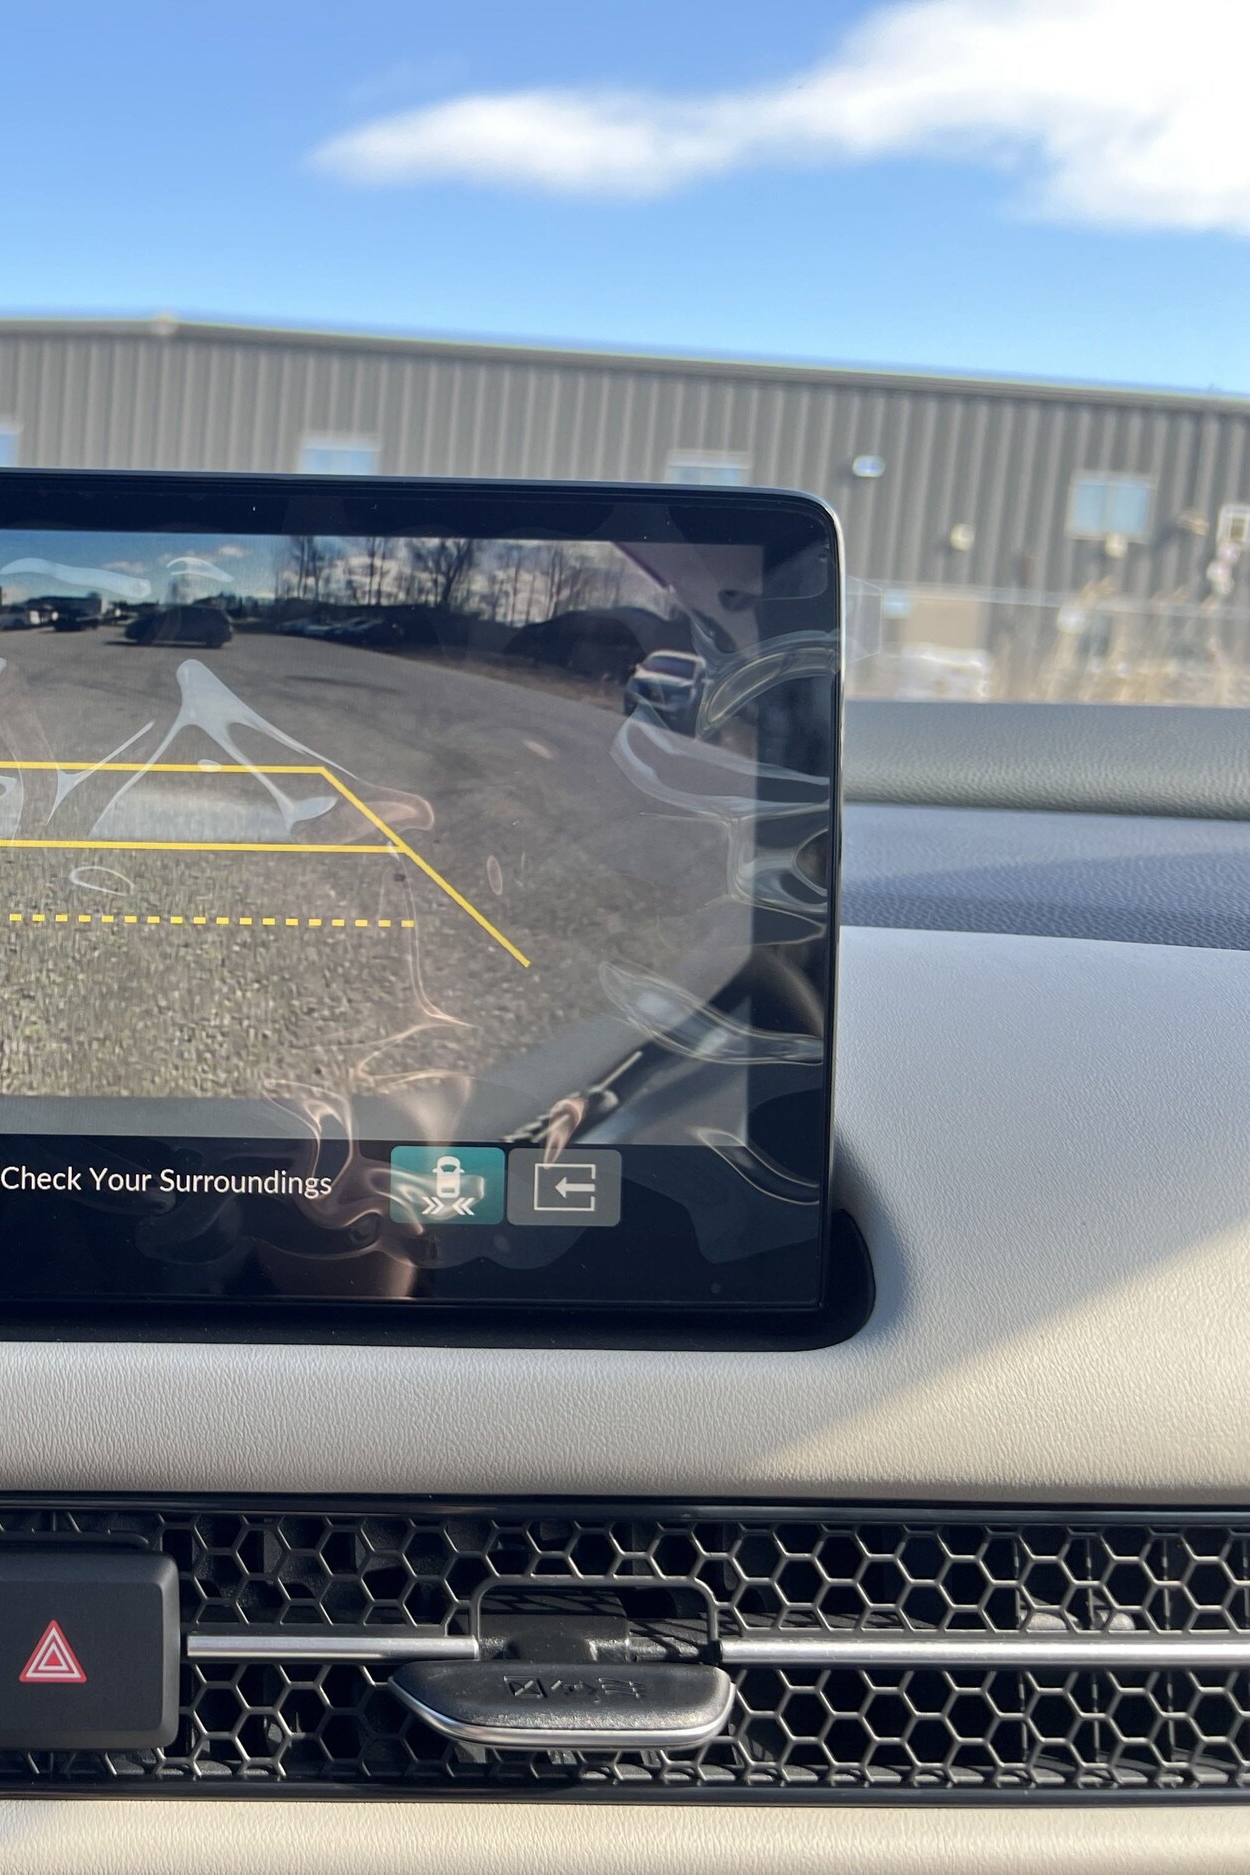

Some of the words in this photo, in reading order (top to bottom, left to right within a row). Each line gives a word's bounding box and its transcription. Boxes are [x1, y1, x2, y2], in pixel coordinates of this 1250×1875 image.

[1, 1166, 82, 1191] Check
[89, 1167, 152, 1192] Your
[159, 1168, 333, 1199] Surroundings
